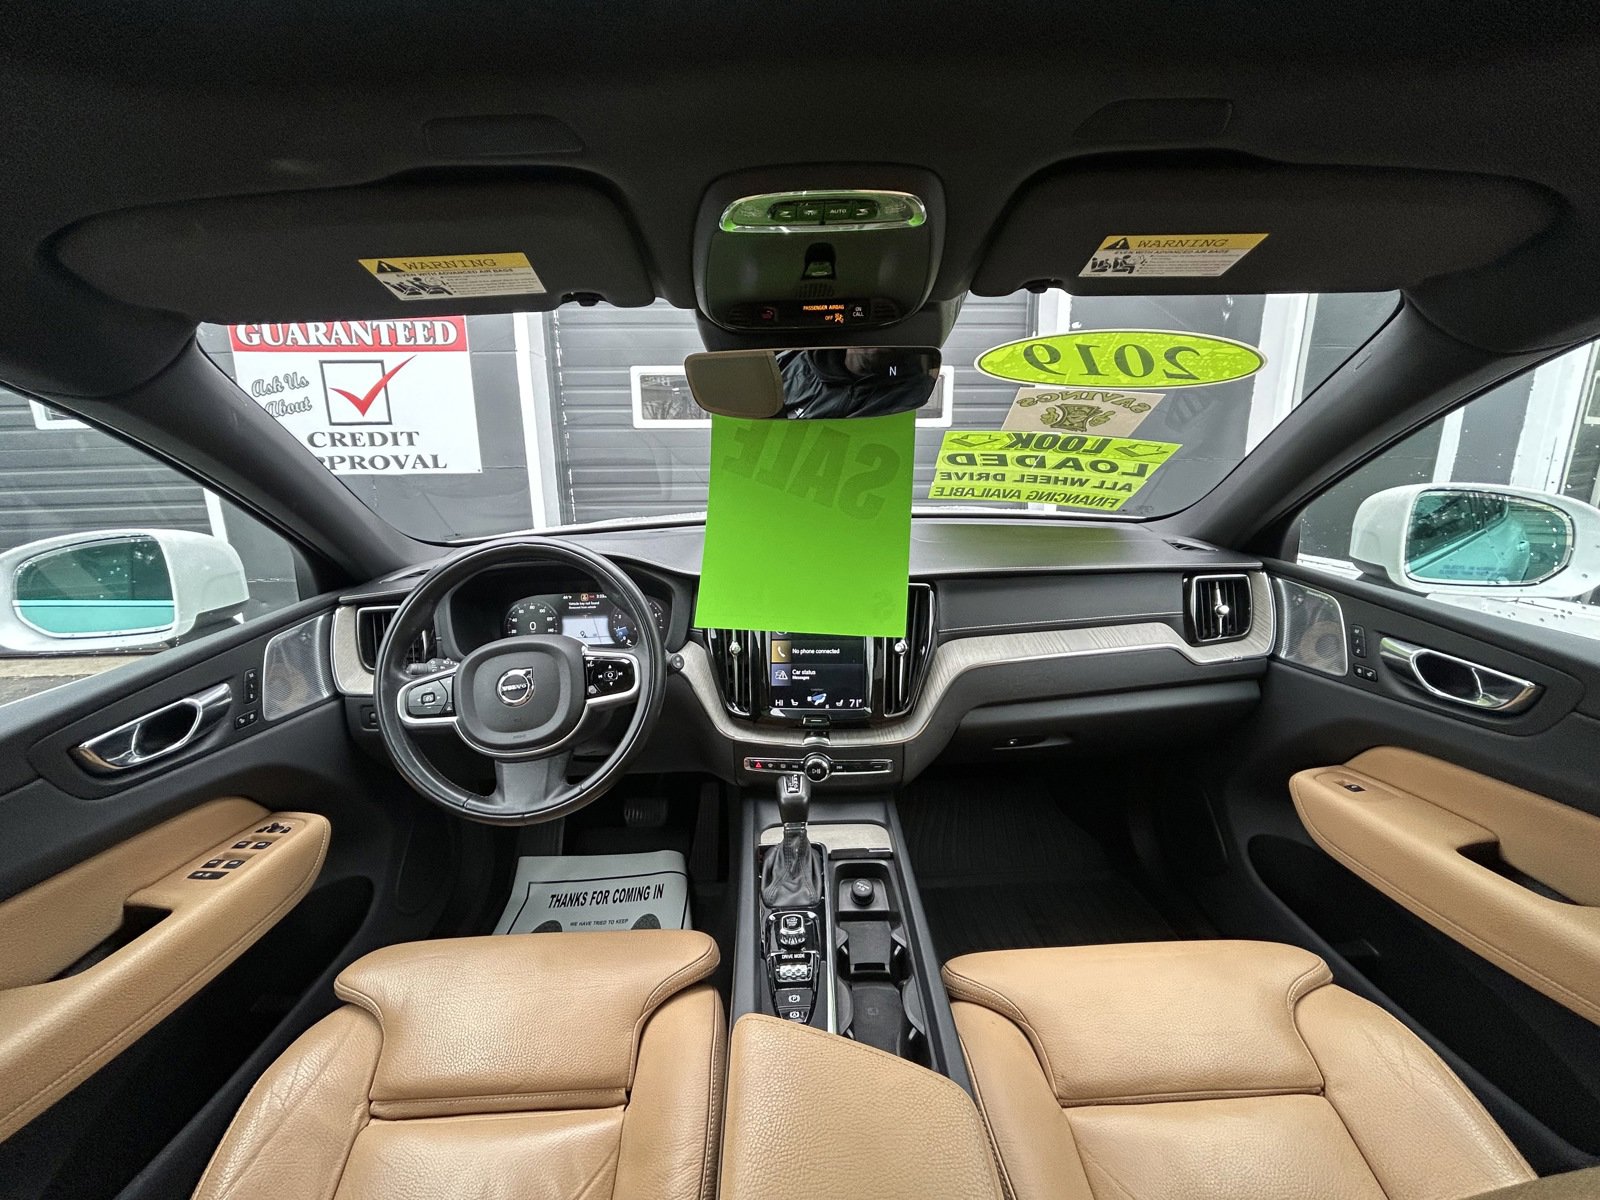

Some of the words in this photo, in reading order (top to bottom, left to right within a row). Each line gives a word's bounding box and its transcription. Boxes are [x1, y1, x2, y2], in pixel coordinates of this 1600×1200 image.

[1137, 239, 1229, 248] WARNING
[403, 259, 497, 270] WARNING
[236, 320, 458, 346] GUARANTEED
[889, 366, 897, 376] N
[251, 376, 284, 397] Ask
[284, 372, 309, 389] Us
[266, 397, 312, 418] About
[307, 431, 420, 448] CREDIT
[316, 454, 448, 470] PROVAL
[529, 621, 537, 631] 0
[501, 683, 528, 691] VOLVO
[548, 891, 588, 908] THANKS
[589, 890, 610, 906] FOR
[612, 886, 650, 904] COMING
[652, 883, 665, 899] IN
